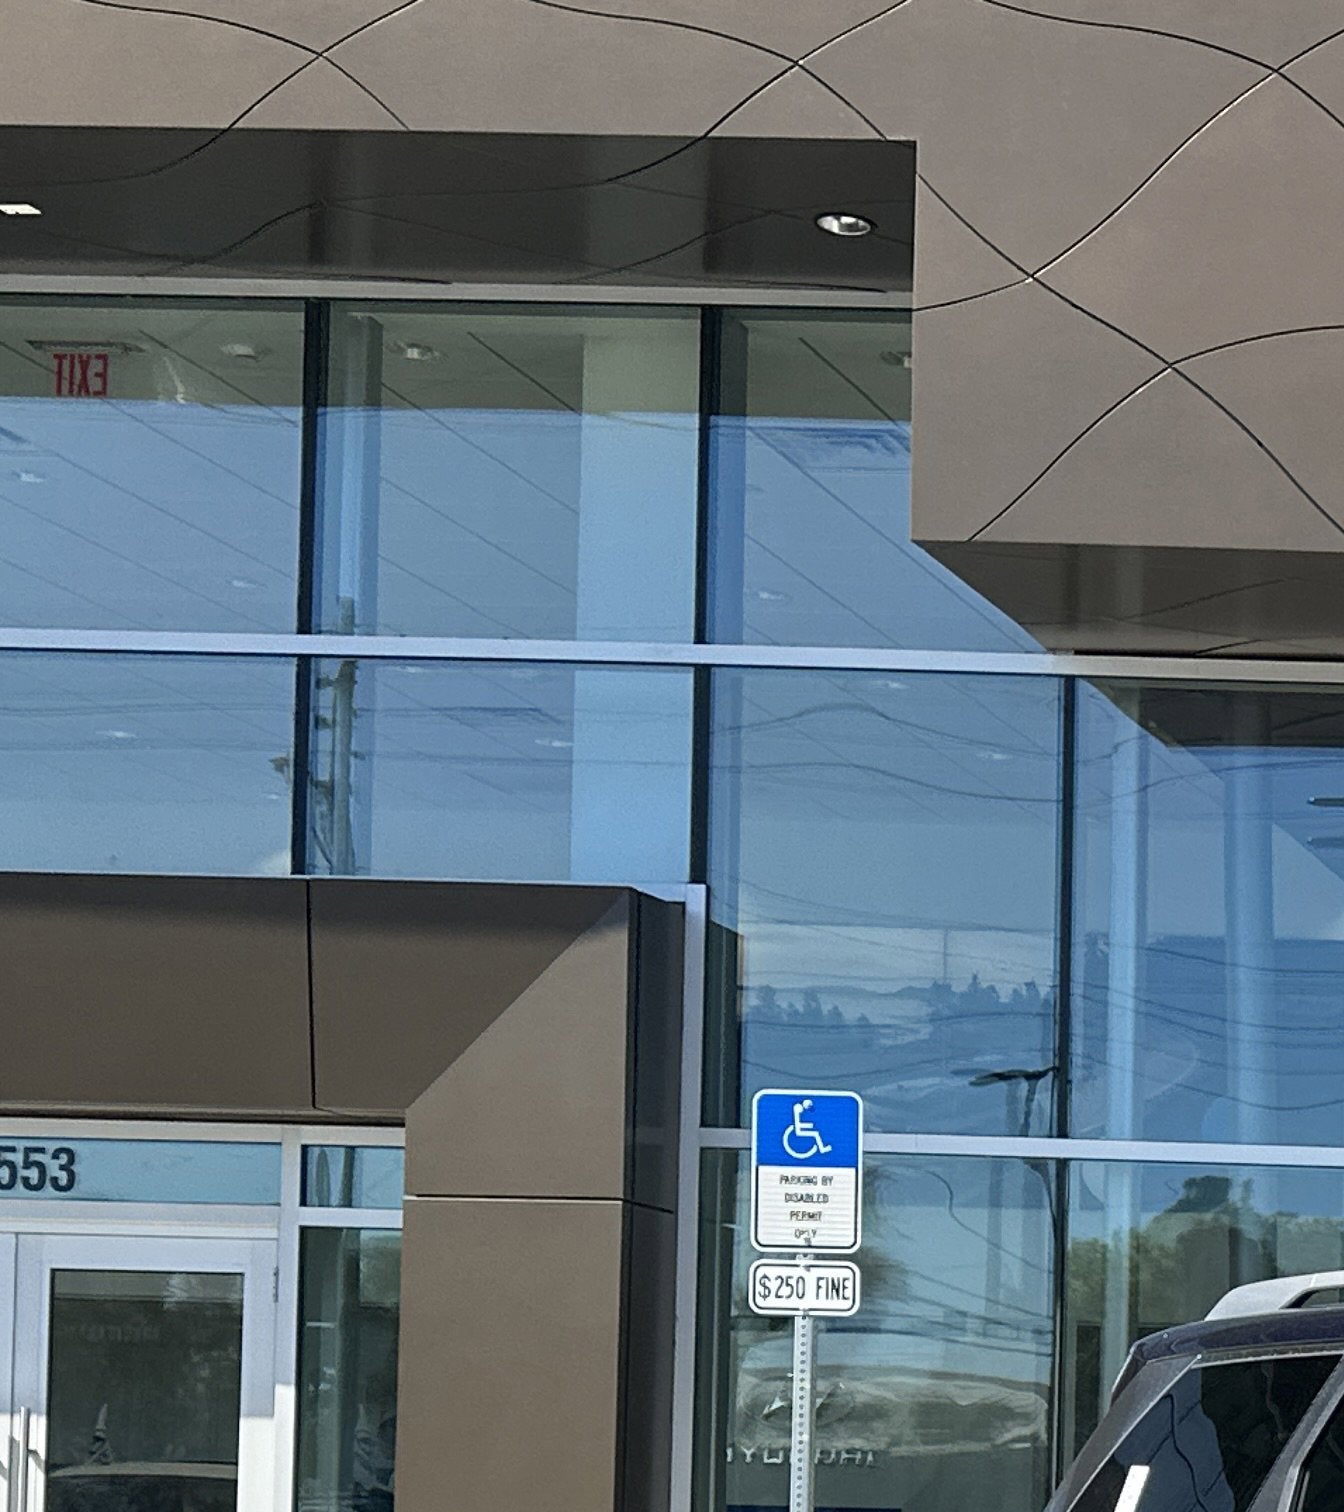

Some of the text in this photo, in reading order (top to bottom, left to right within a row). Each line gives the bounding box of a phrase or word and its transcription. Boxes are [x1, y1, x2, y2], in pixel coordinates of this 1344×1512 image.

[0, 1145, 76, 1193] 553
[821, 1175, 834, 1187] BY
[784, 1192, 829, 1204] DISABLED
[759, 1273, 851, 1301] $250 FINE
